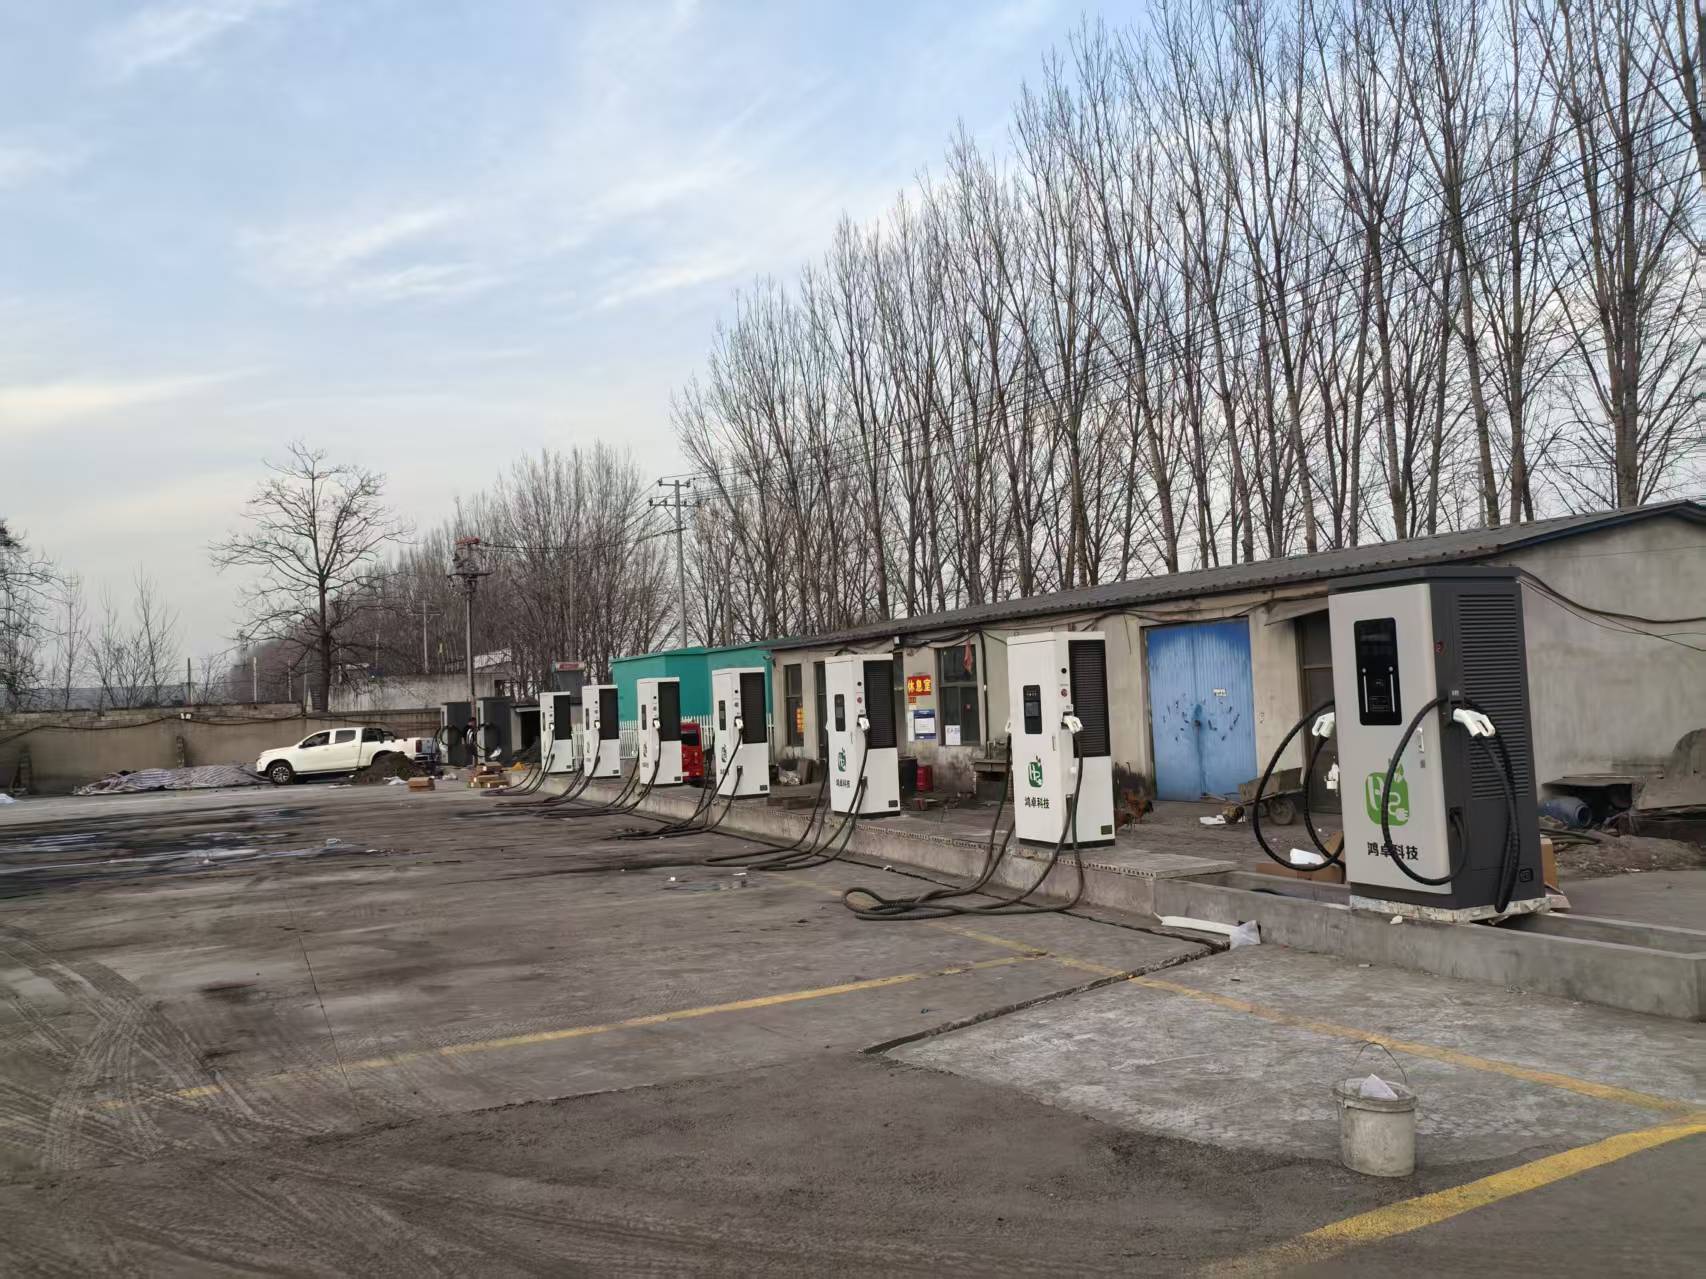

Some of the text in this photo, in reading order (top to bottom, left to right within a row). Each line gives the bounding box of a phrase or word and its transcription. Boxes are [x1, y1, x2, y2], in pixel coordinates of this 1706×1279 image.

[908, 679, 931, 693] 休息室
[1024, 796, 1049, 808] 鸿卓科技
